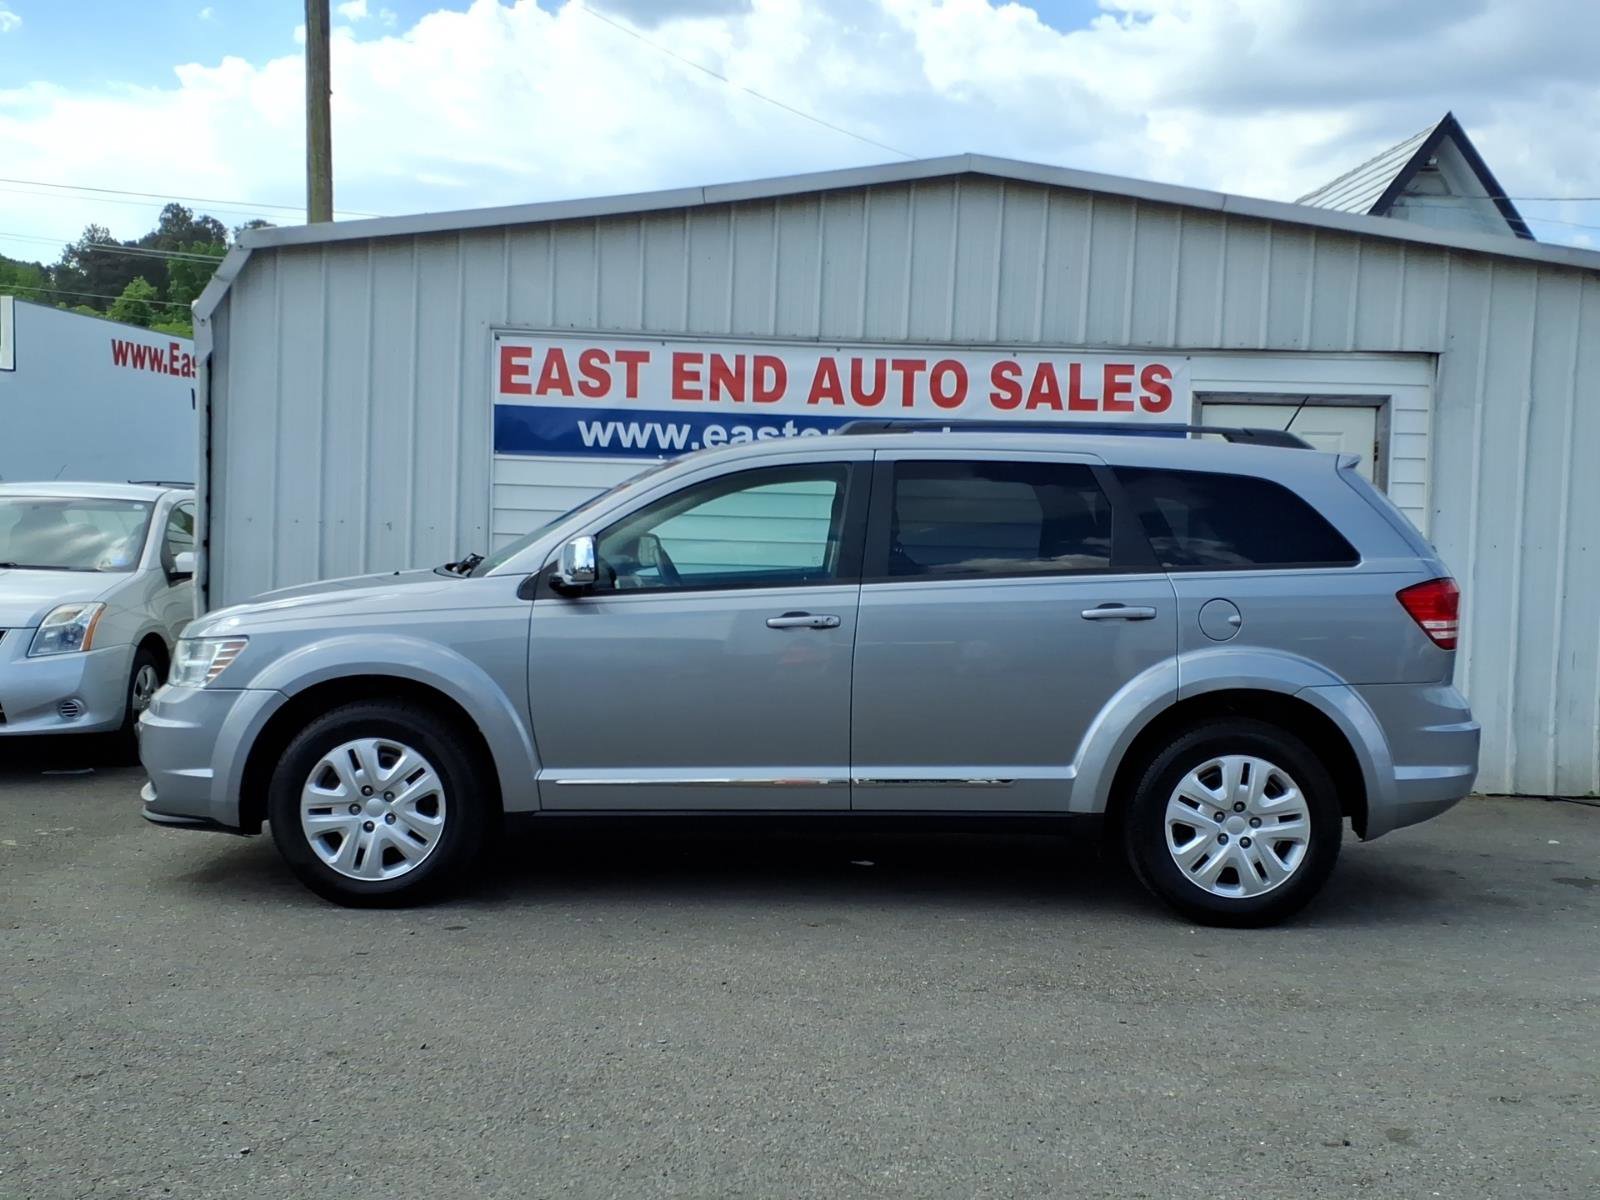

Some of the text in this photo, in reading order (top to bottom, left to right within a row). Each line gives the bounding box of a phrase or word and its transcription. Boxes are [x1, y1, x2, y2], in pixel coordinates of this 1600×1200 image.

[500, 346, 1173, 413] EAST END AUTO SALES
